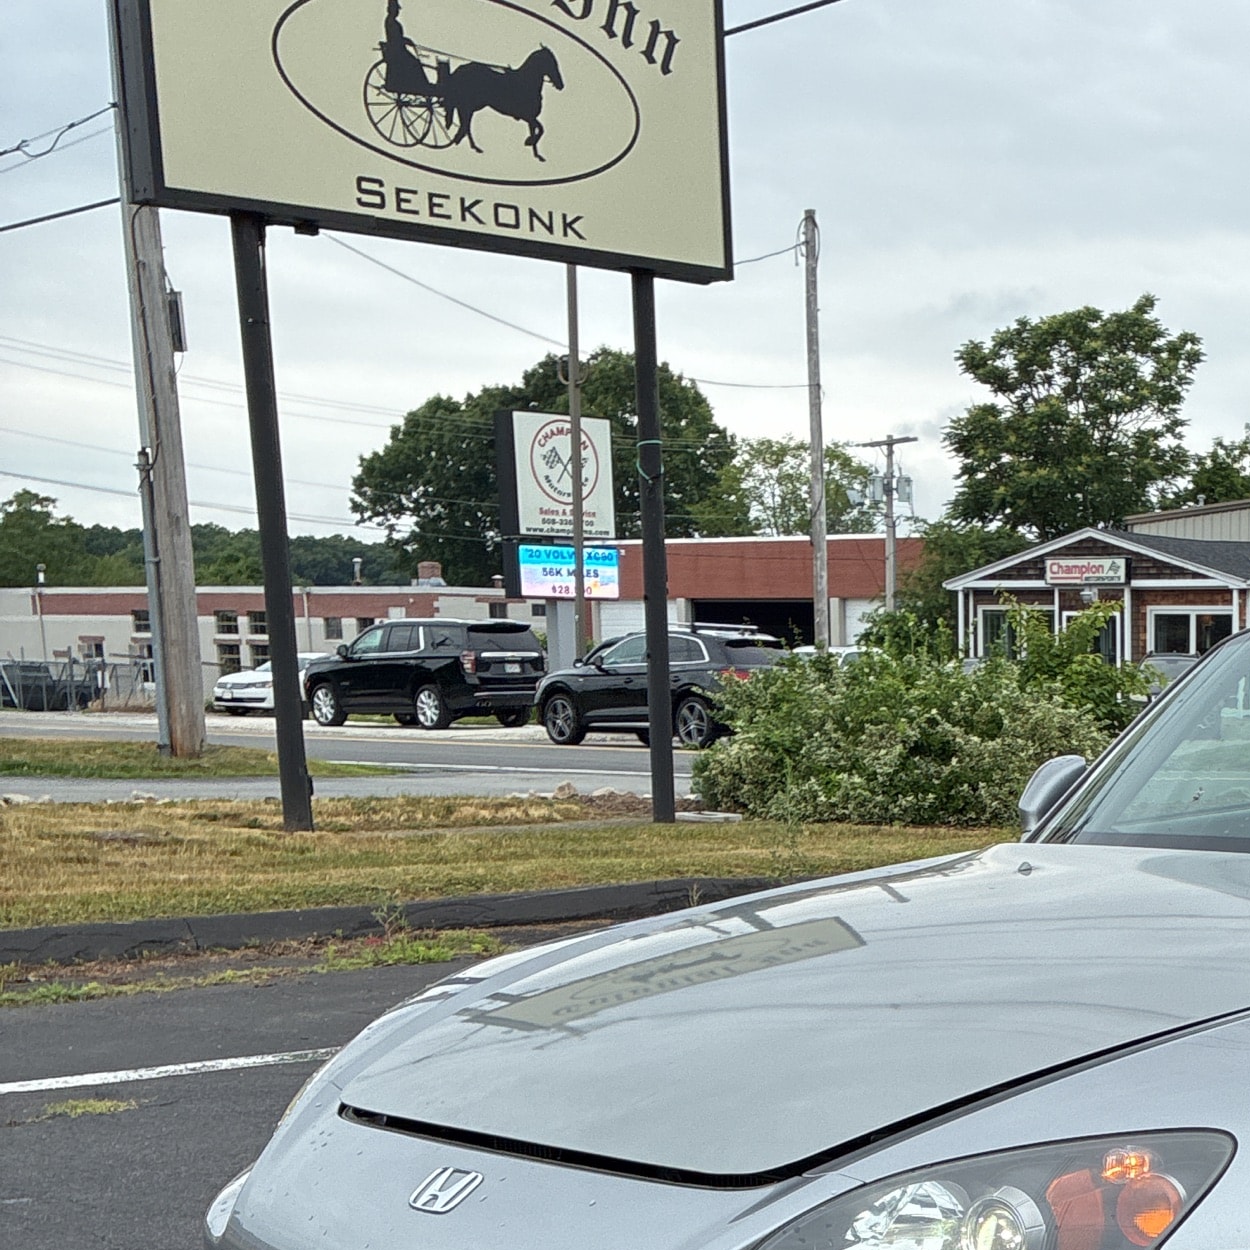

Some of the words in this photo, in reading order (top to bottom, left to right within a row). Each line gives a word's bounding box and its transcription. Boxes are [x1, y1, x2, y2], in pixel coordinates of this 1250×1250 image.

[355, 176, 588, 241] SEEKONK
[537, 426, 590, 452] CHAMPN
[543, 549, 576, 560] VOLV
[566, 568, 600, 578] MES
[1049, 562, 1104, 581] Champion
